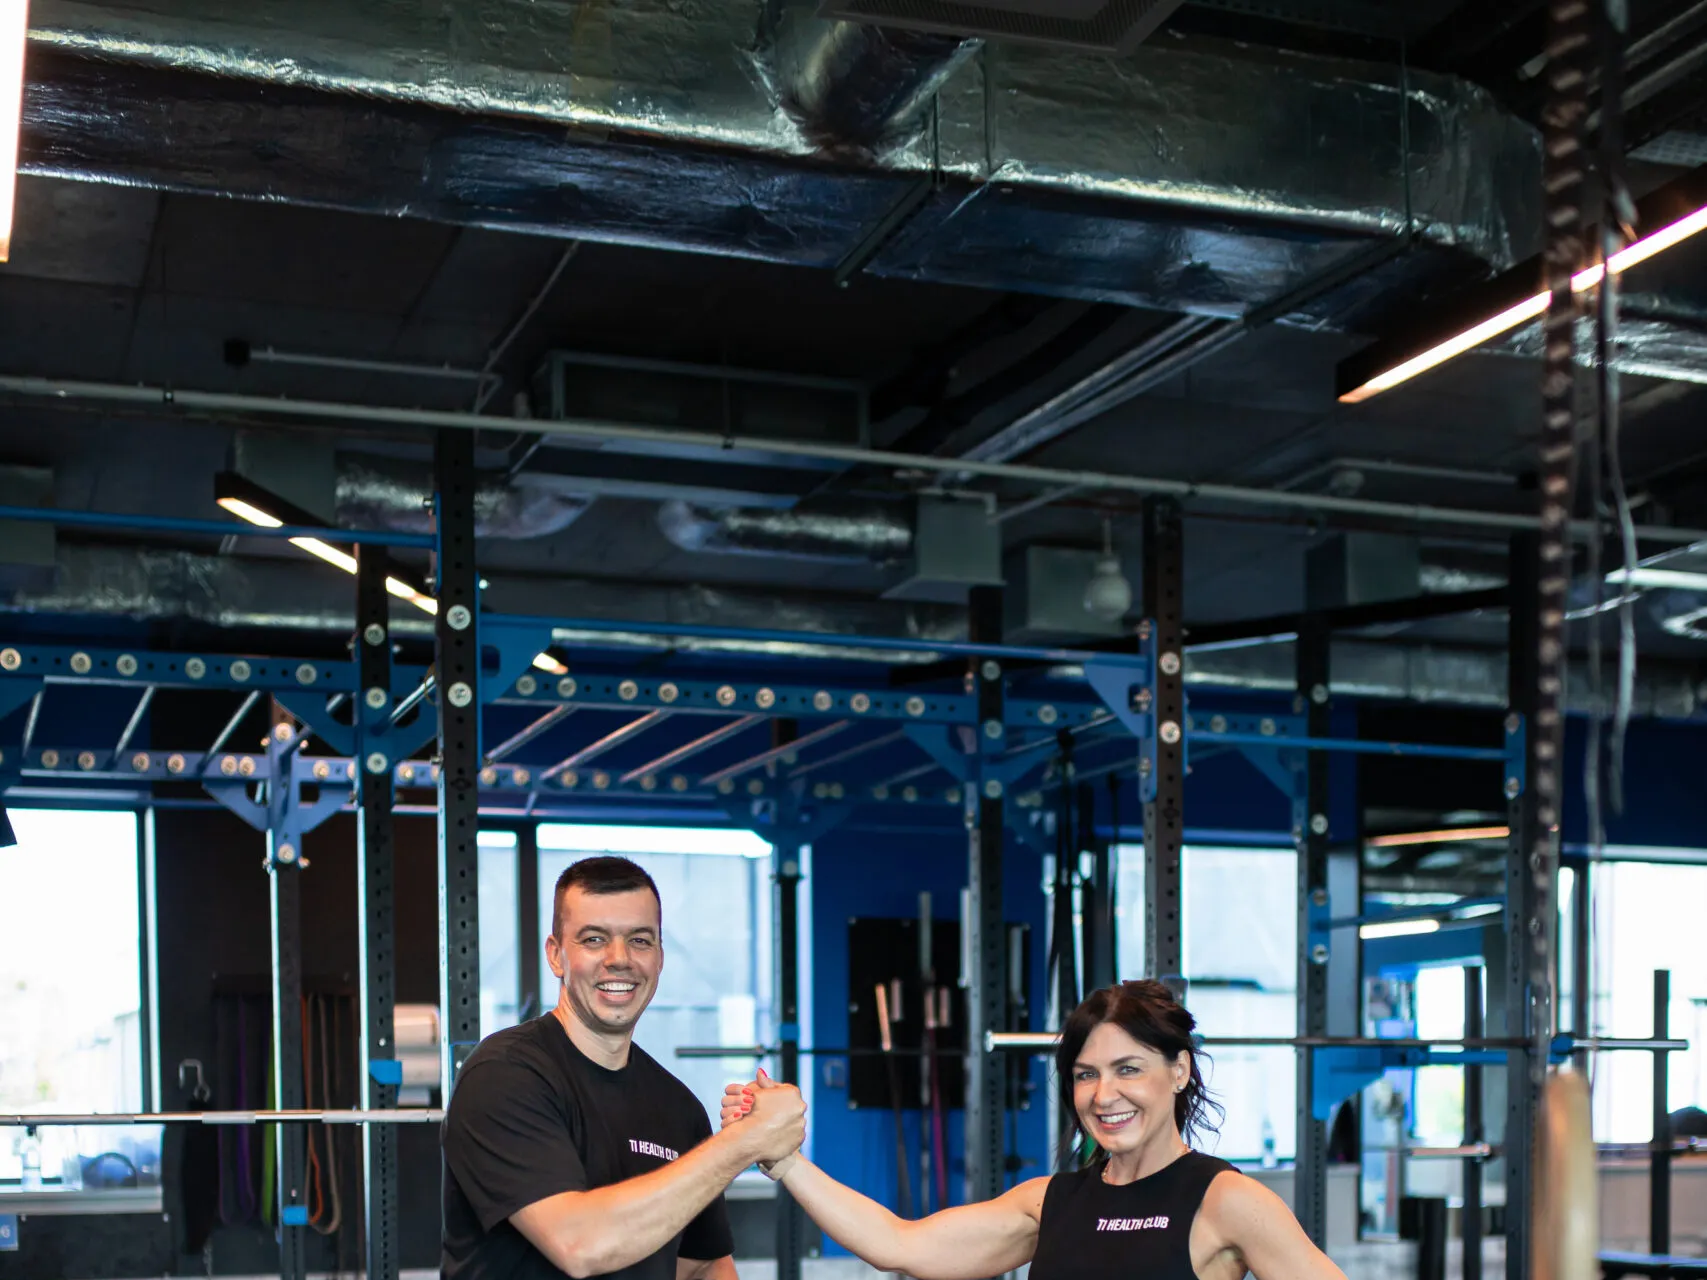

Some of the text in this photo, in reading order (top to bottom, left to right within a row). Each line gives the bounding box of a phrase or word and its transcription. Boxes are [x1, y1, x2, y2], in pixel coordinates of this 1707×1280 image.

[628, 1139, 638, 1153] TI
[639, 1140, 665, 1159] HEALTH
[1096, 1215, 1169, 1231] TI HEALTH CLUB
